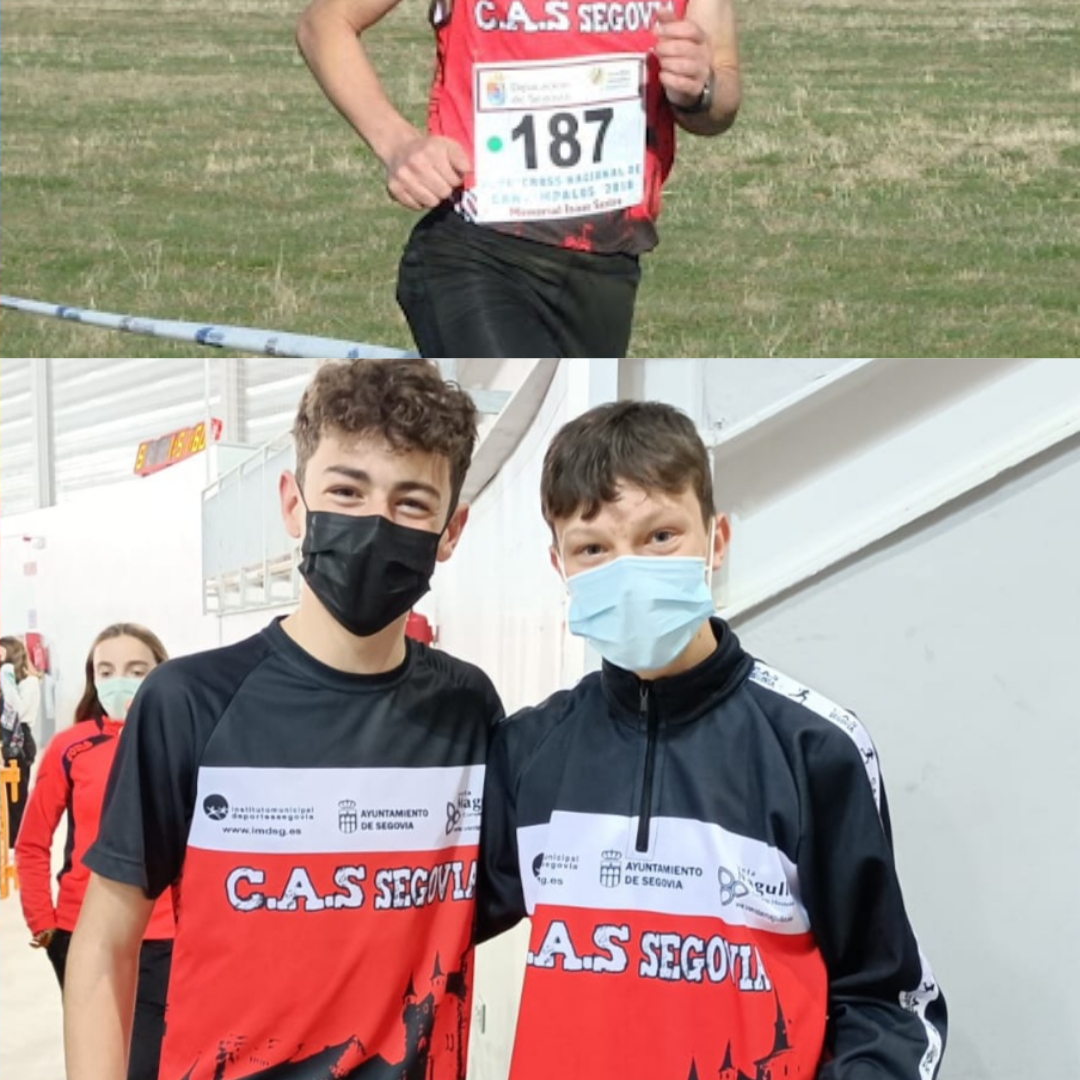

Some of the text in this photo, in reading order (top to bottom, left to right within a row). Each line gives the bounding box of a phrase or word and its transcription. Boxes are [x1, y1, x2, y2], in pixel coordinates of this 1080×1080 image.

[511, 107, 614, 170] 187
[360, 808, 429, 819] AYUNTAMIENTO
[222, 826, 302, 838] www.imdsg.es
[360, 820, 415, 831] DE SEGOVIA
[624, 861, 703, 878] AYUNTAMIENTO
[225, 865, 367, 912] C.A.S
[624, 876, 684, 890] DE SEGOVIA
[527, 920, 631, 974] .A.S
